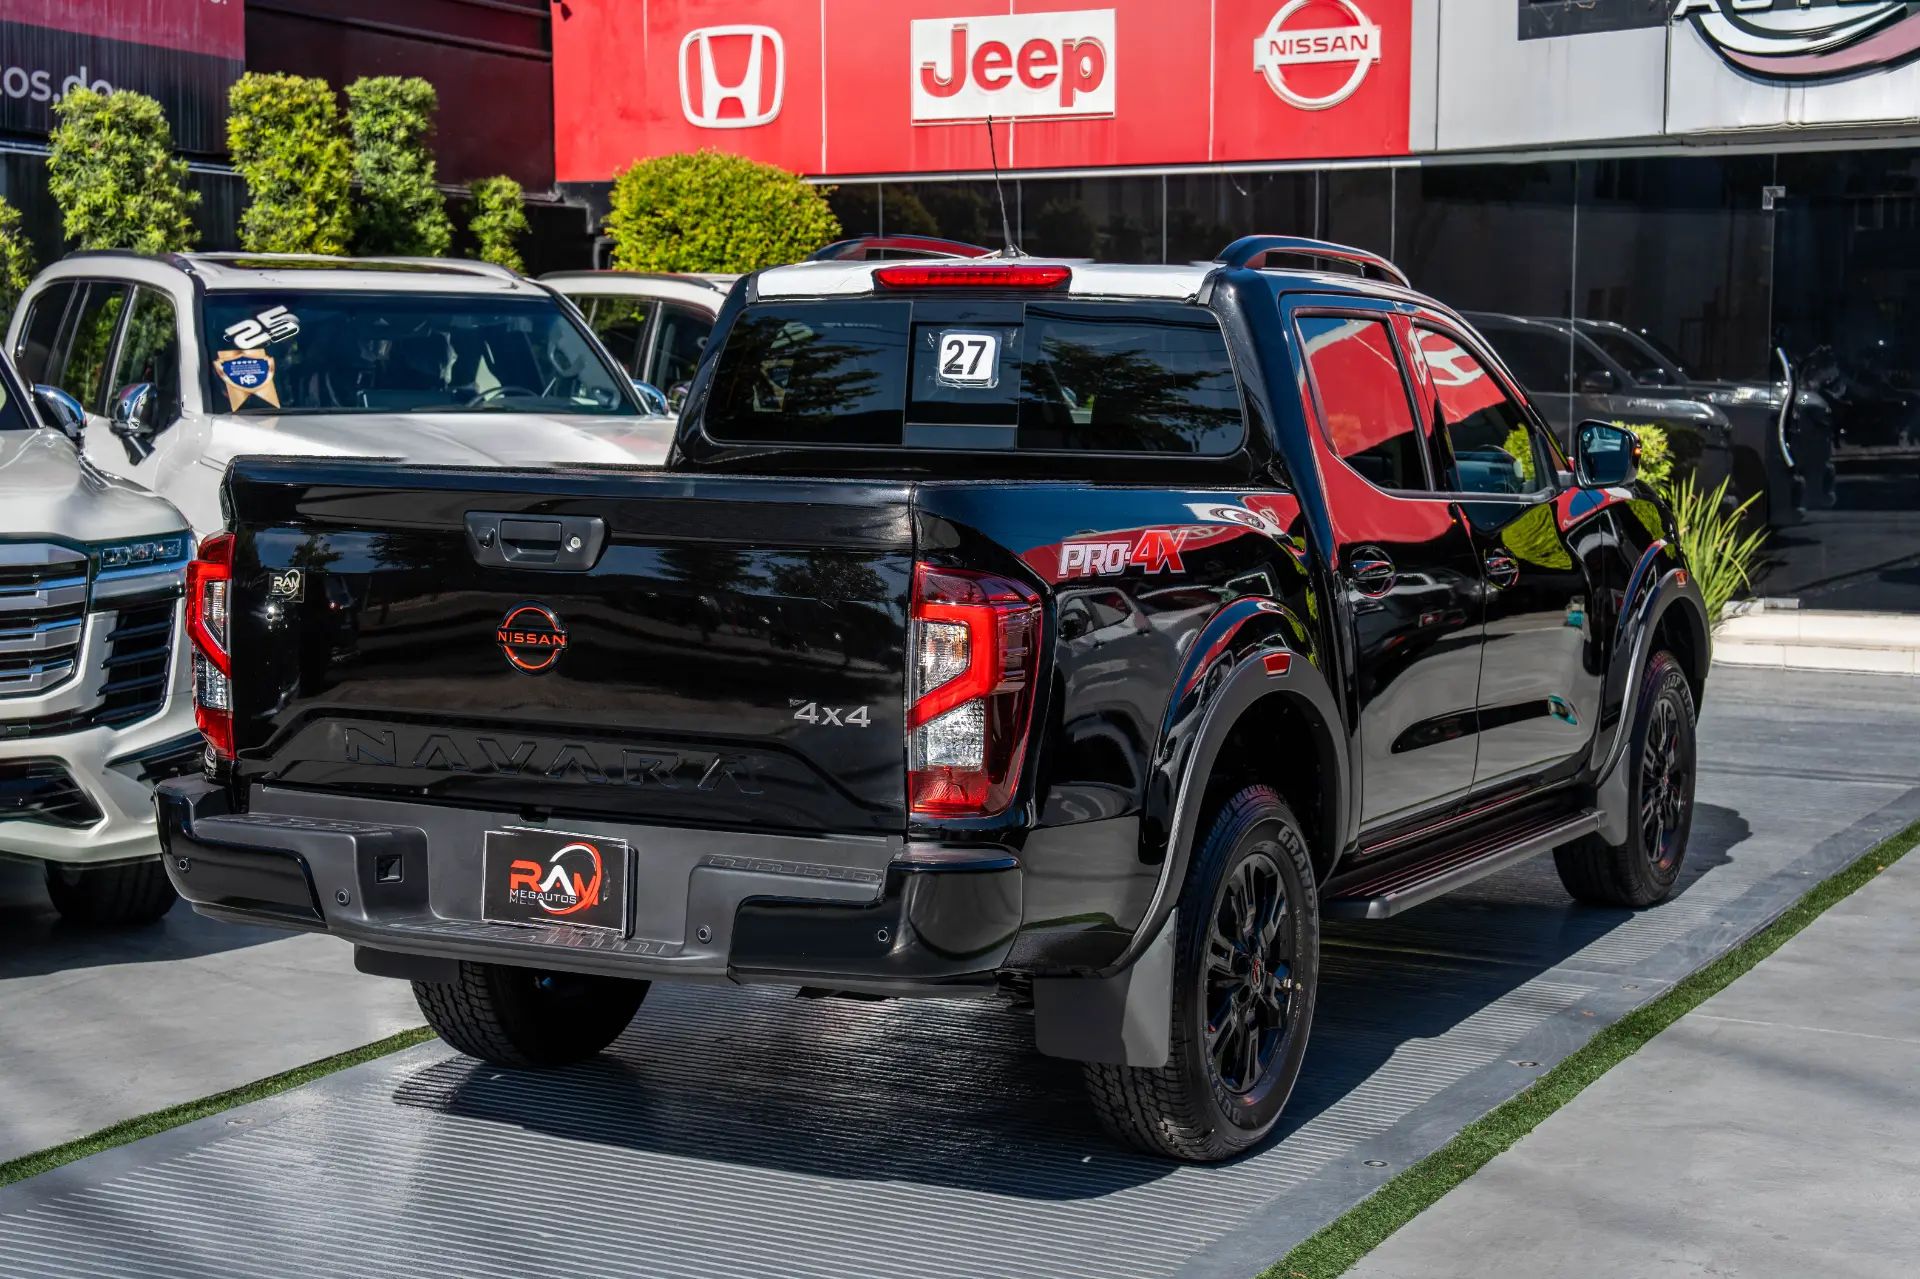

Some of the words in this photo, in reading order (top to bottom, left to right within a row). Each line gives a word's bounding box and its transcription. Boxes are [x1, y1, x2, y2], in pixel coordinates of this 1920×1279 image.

[1269, 34, 1368, 55] NISSAN
[920, 24, 1106, 107] Jeep
[224, 305, 300, 349] 25
[942, 340, 987, 375] 27
[497, 630, 566, 646] NISSAN
[793, 702, 871, 728] 4x4
[345, 727, 764, 795] NAVARA
[509, 860, 600, 907] RAM
[509, 888, 577, 905] MEGAUTOS
